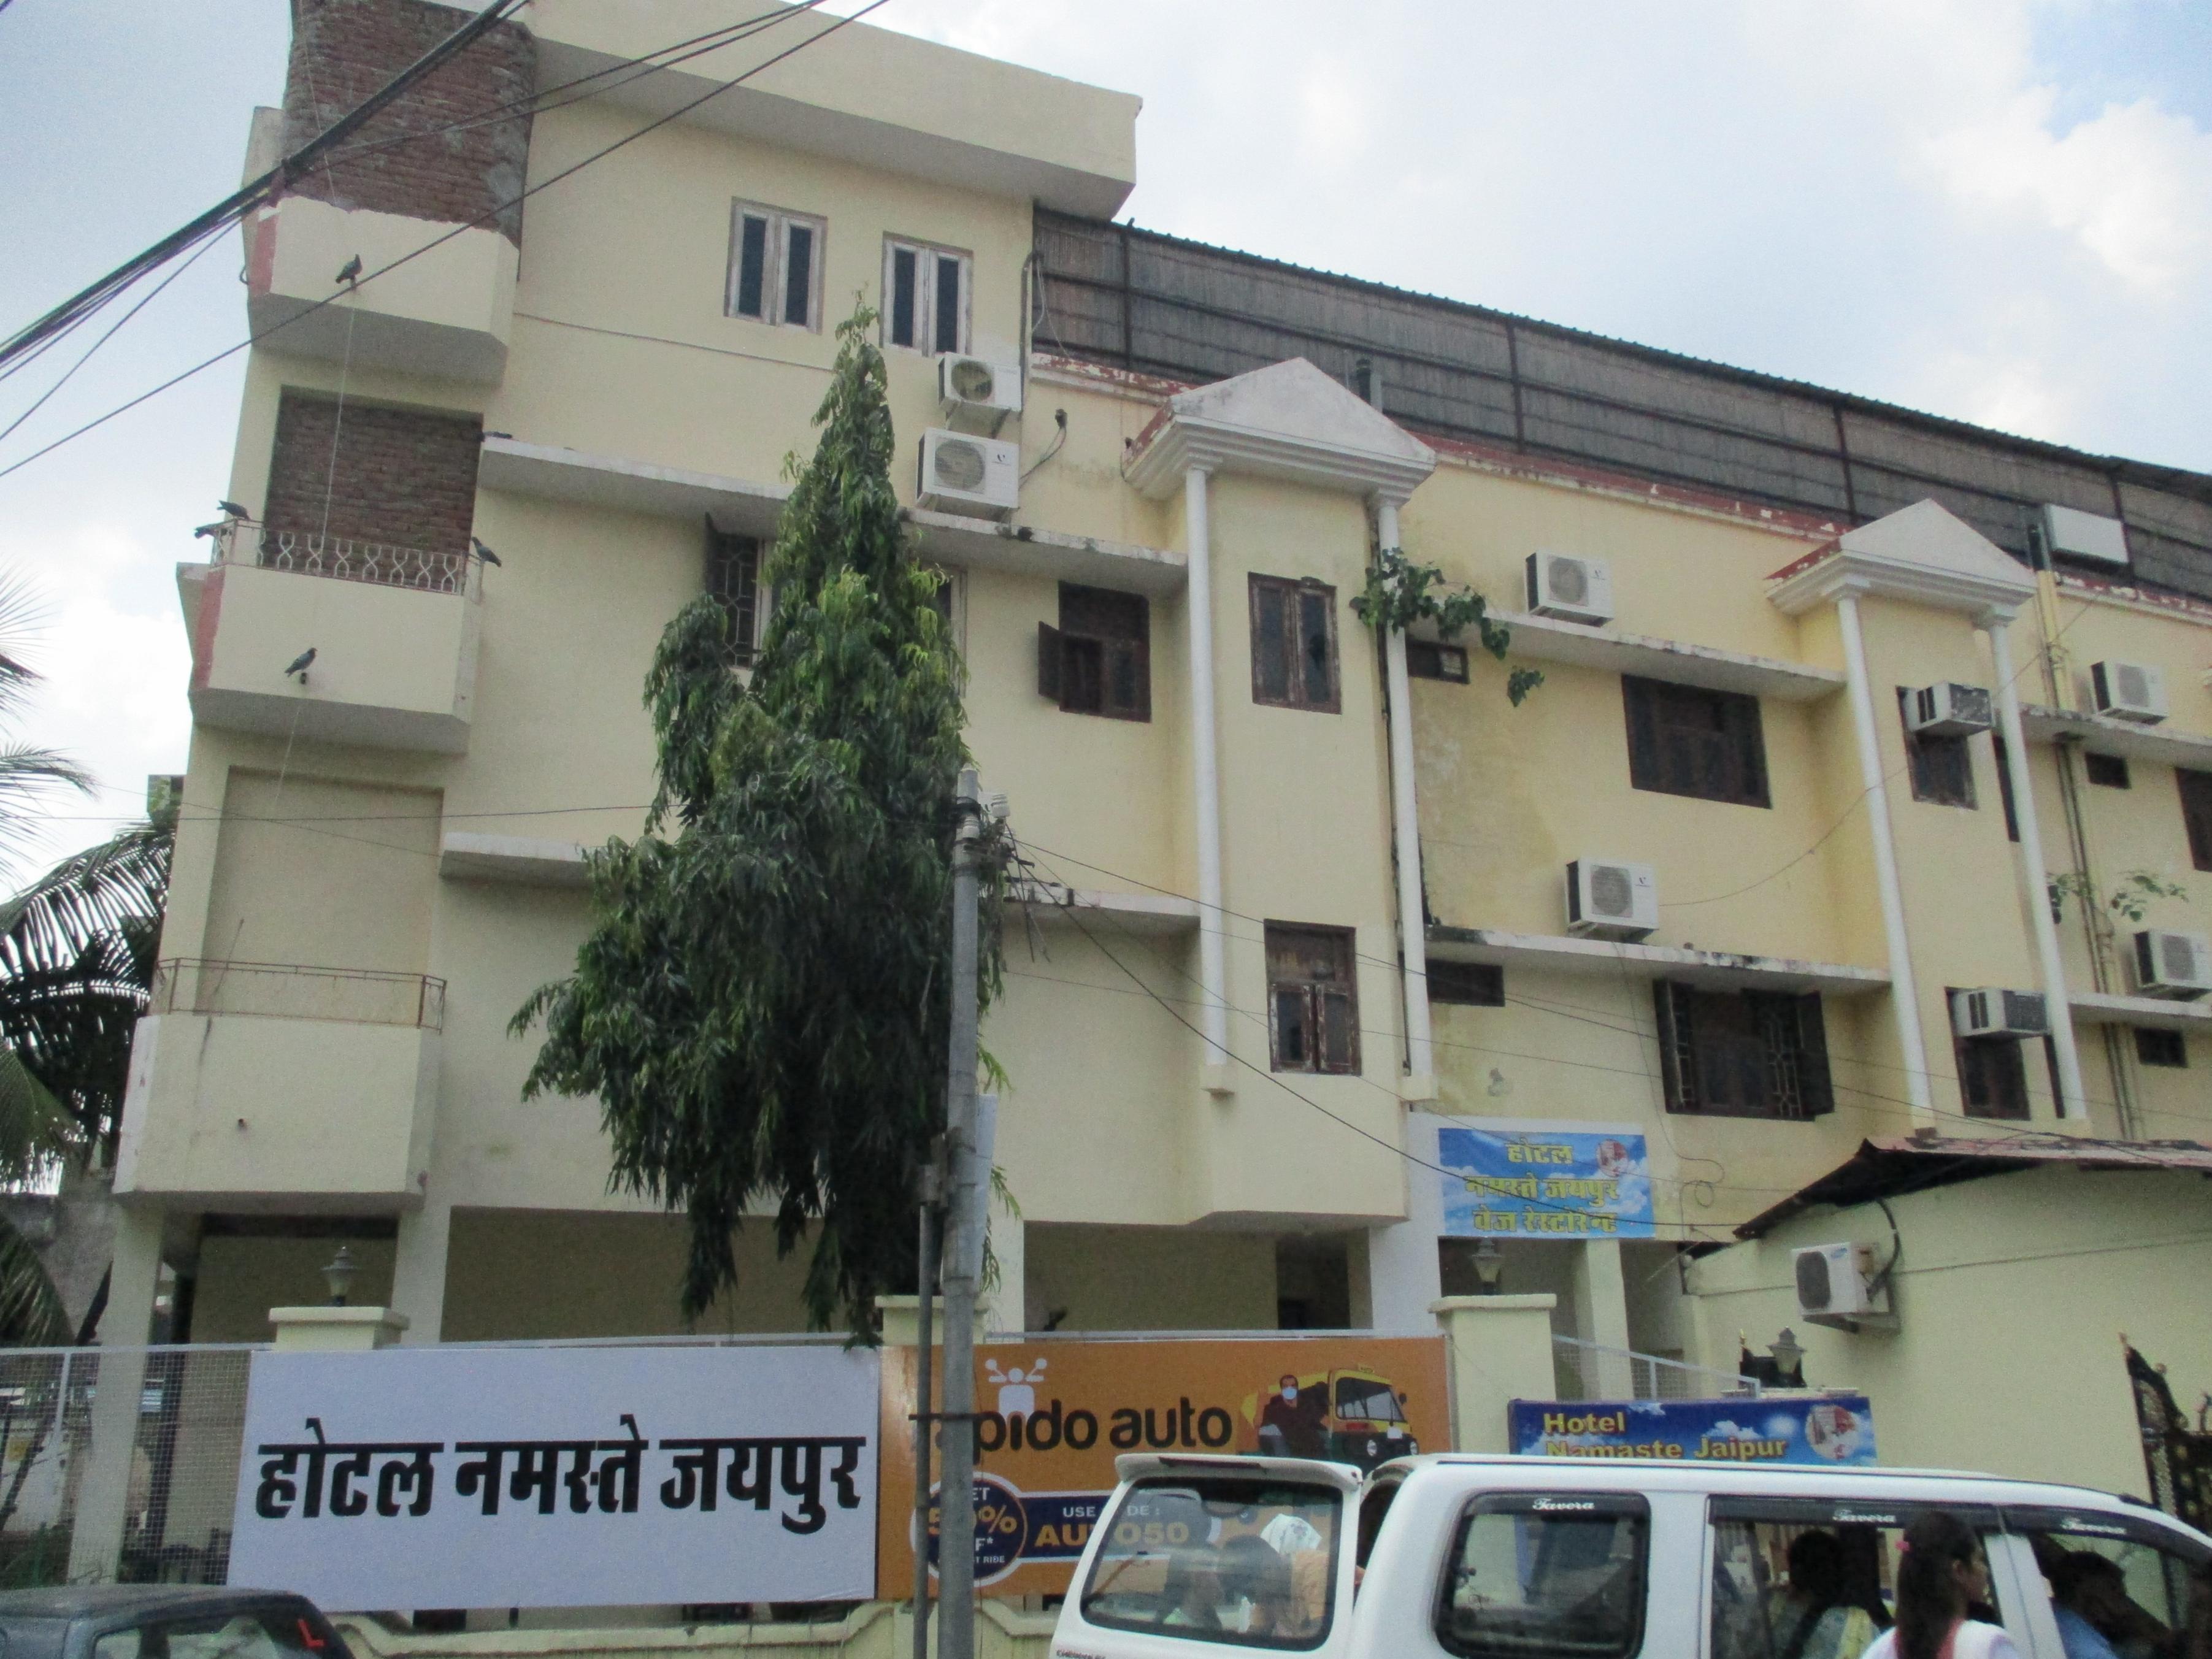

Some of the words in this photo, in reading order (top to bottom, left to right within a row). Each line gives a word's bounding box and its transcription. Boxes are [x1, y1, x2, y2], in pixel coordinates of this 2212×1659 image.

[1504, 1138, 1574, 1164] होटल
[1464, 1173, 1538, 1198] नमस्ते
[1543, 1178, 1619, 1208] जयपुर
[1472, 1203, 1518, 1232] वेज
[935, 1398, 1099, 1466] pido
[1109, 1396, 1233, 1449] auto
[1543, 1411, 1627, 1434] Hotel
[1546, 1439, 1684, 1458] Namaste
[1694, 1436, 1788, 1462] Jaipur
[256, 1417, 444, 1519] होटल
[455, 1414, 648, 1515] नमस्ते
[659, 1436, 867, 1534] जयपुर
[1062, 1506, 1096, 1518] USE
[1532, 1498, 1595, 1511] Tavera
[1034, 1520, 1189, 1547] AUO50
